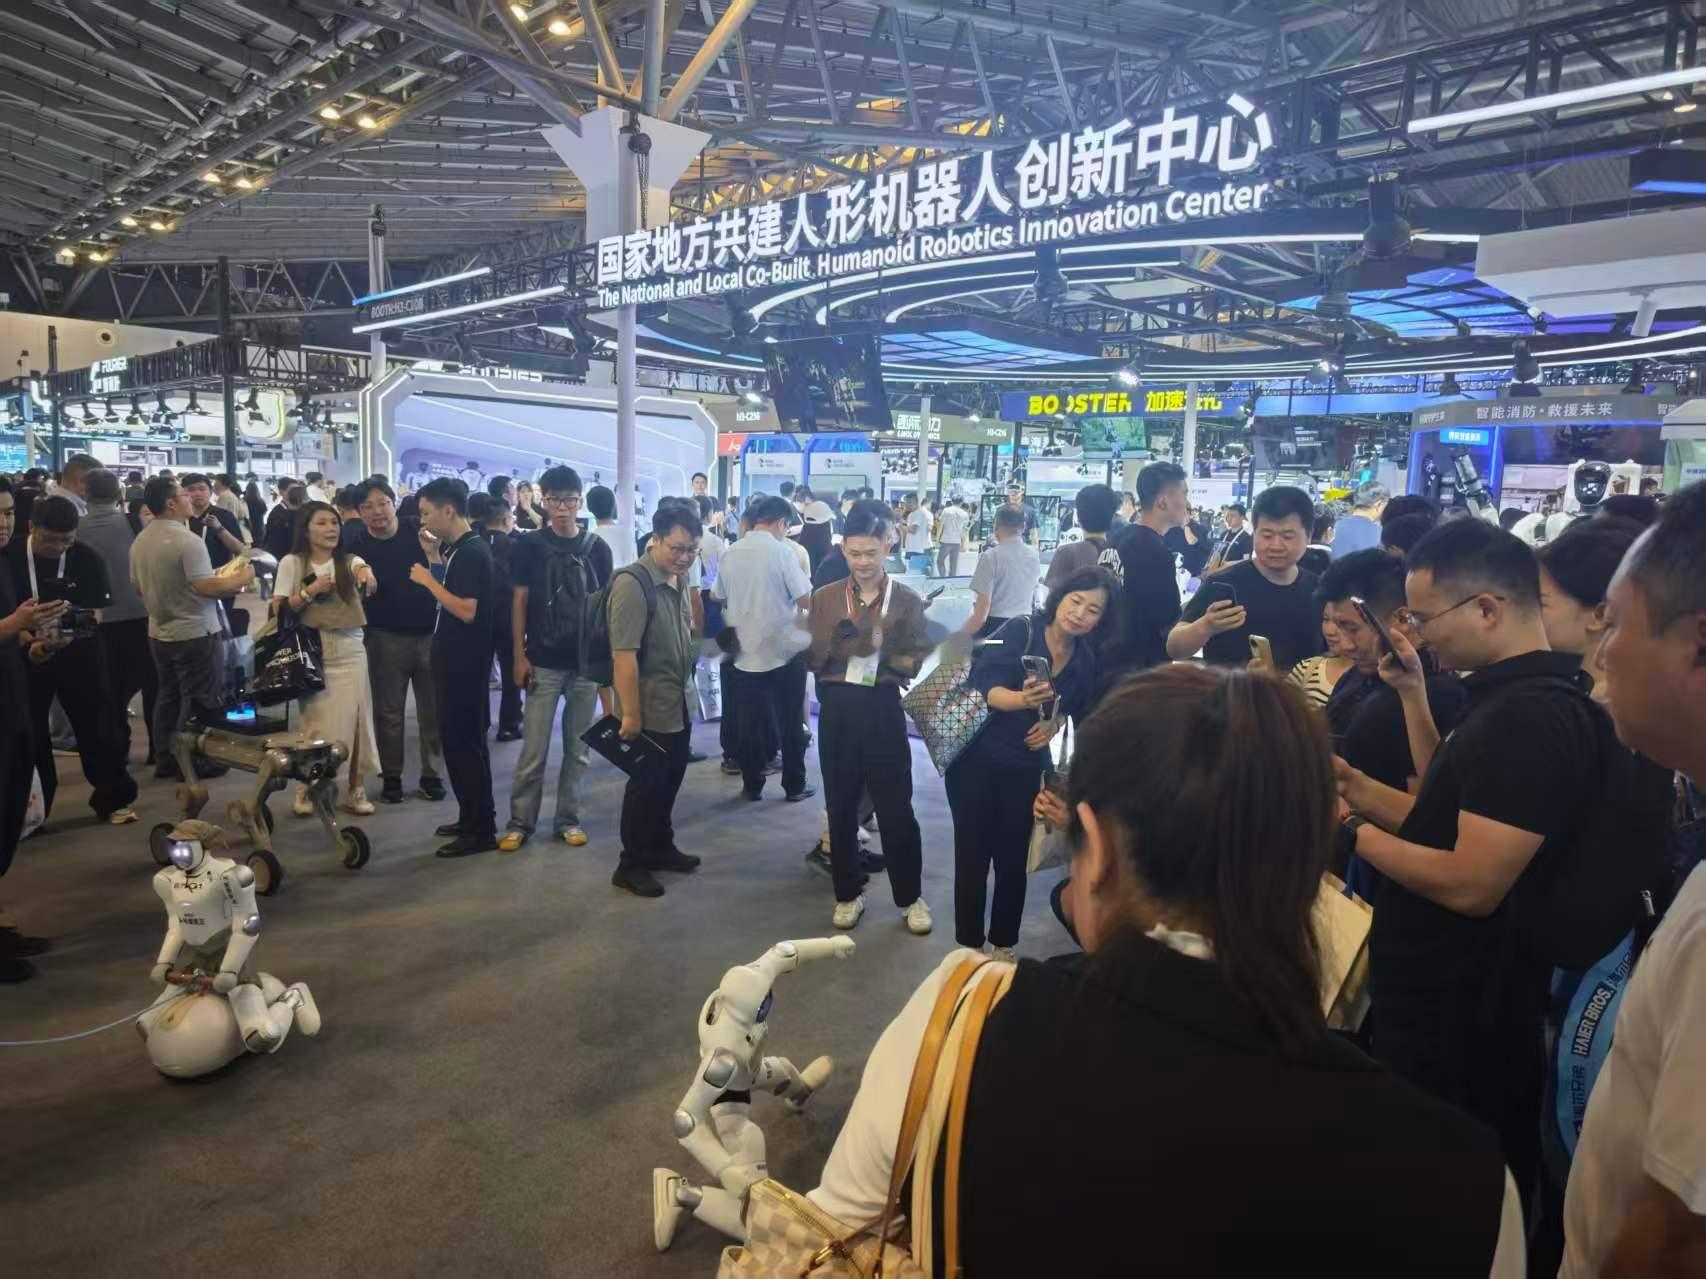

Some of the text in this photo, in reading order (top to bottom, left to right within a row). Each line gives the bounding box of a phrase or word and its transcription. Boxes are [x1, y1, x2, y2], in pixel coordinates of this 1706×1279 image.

[597, 93, 1274, 285] 国家地方共建人形机器人创新中心
[598, 183, 1268, 308] The National and Local Co-Built Humanoid Robotics Innovation Center
[1573, 1018, 1596, 1056] HAIER
